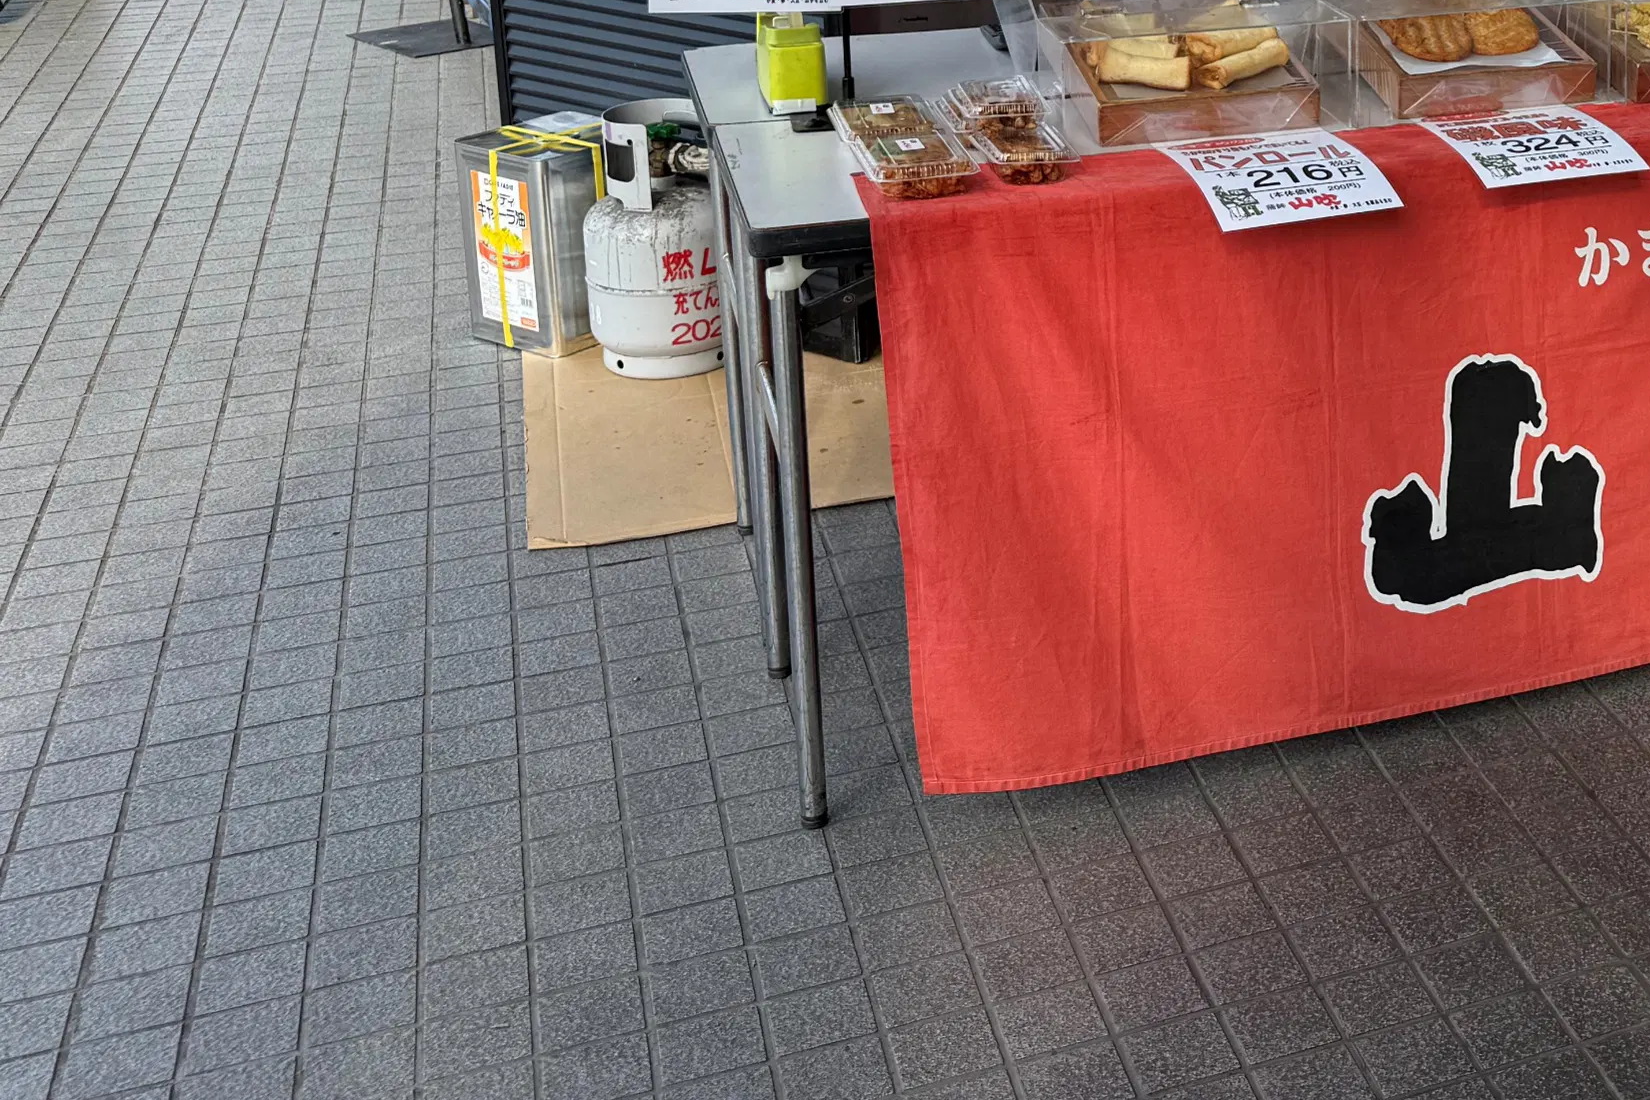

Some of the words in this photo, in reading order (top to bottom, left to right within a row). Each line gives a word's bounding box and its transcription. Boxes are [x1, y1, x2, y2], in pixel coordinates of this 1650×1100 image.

[1501, 134, 1581, 154] 324
[1190, 144, 1351, 171] パンロール
[1246, 163, 1334, 189] 216
[477, 201, 526, 228] キャーラ油
